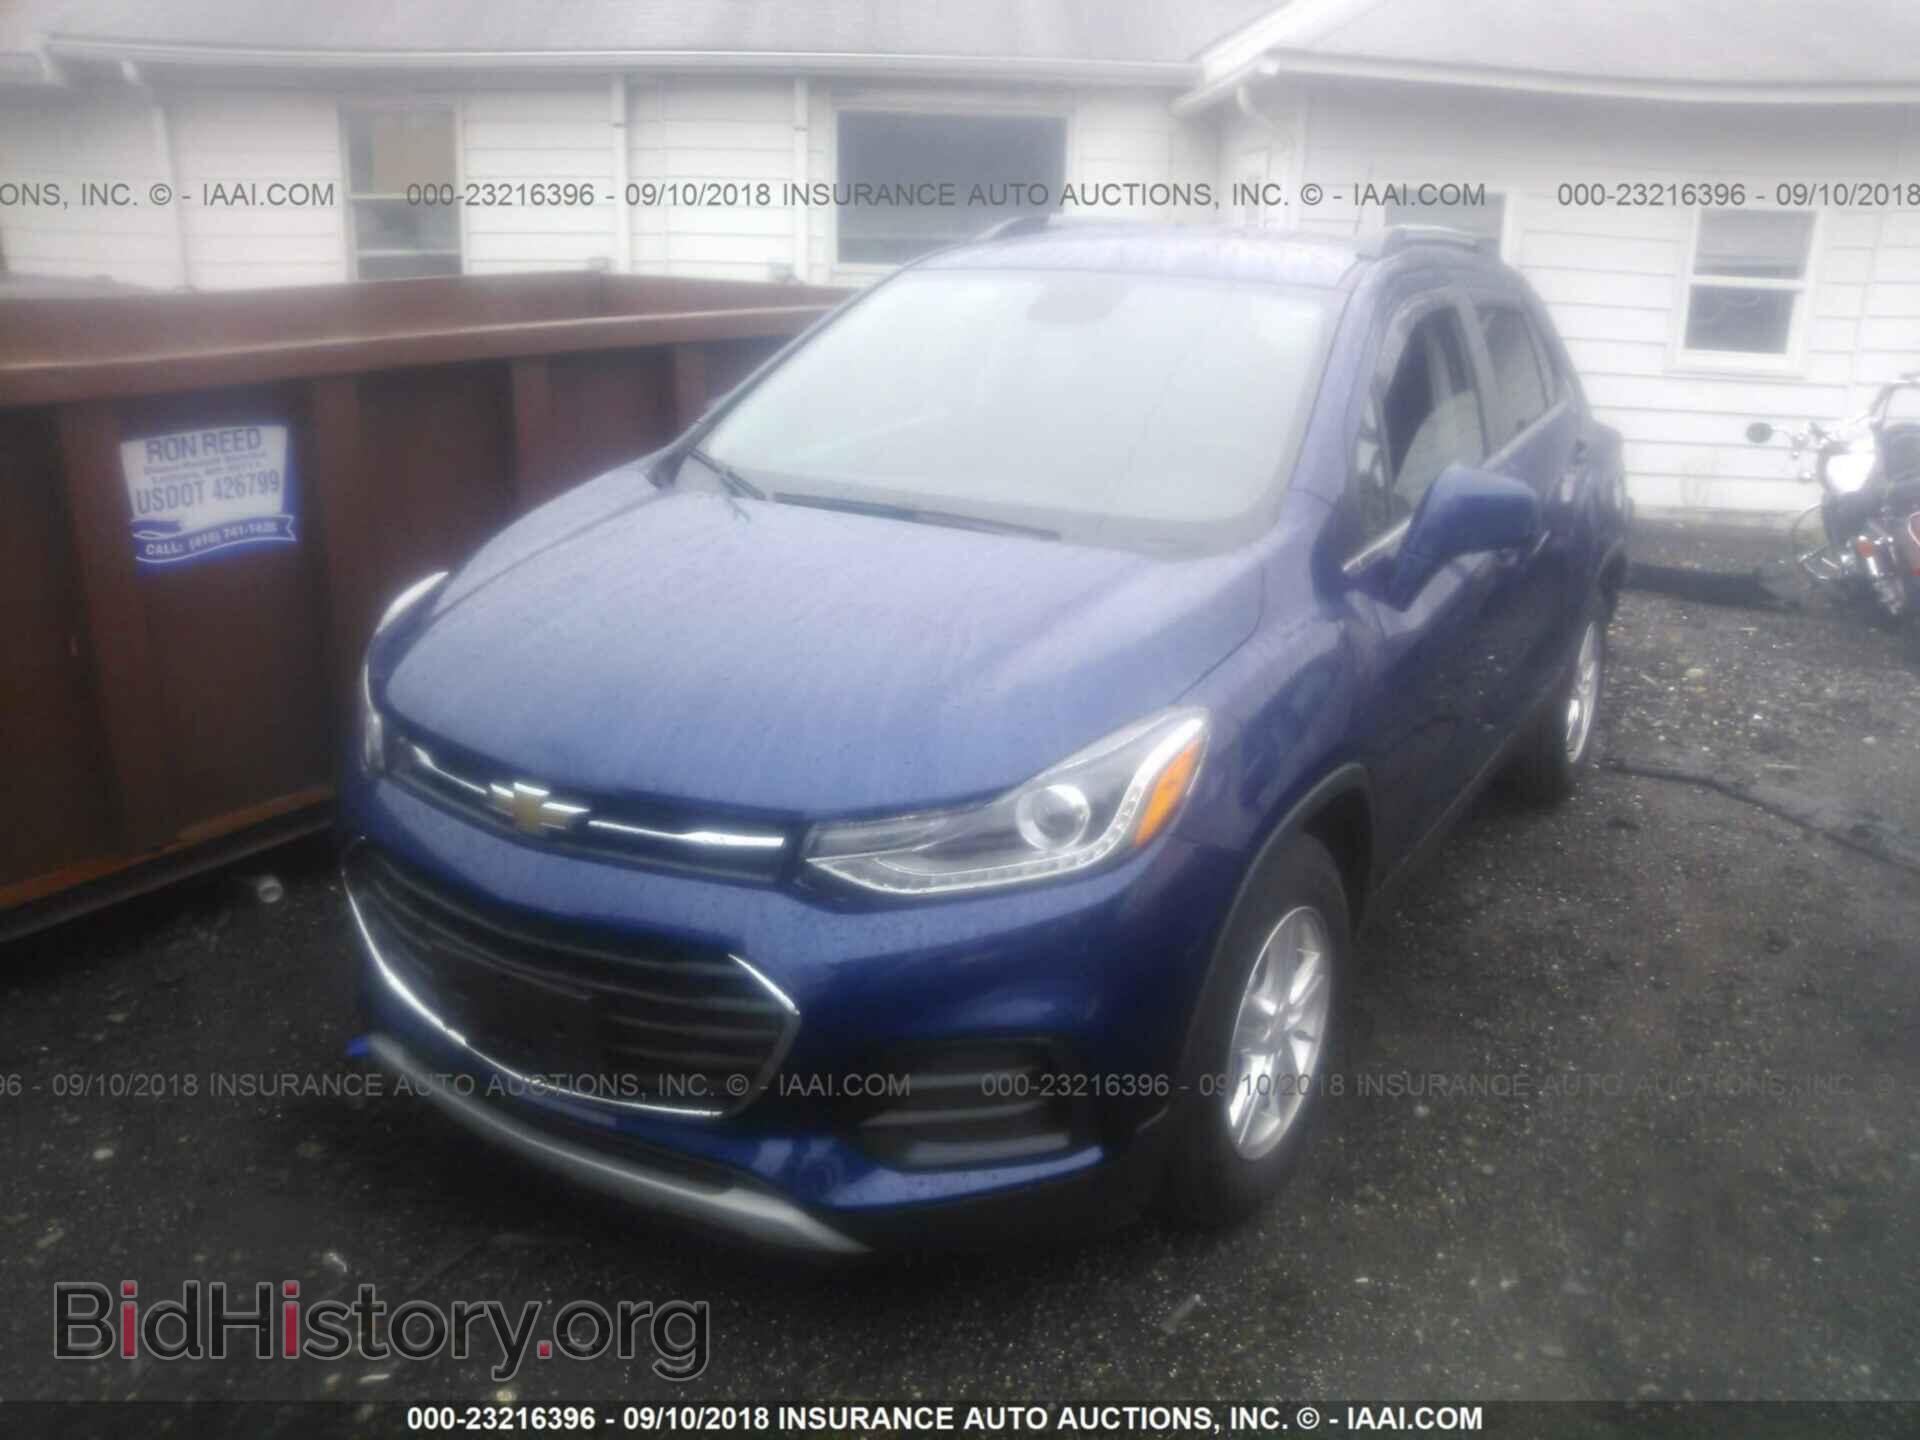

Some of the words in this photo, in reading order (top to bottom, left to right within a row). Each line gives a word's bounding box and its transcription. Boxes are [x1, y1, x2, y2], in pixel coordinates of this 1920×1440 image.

[144, 436, 197, 464] RON
[202, 427, 262, 455] REED
[136, 480, 205, 515] USDOT
[212, 469, 281, 501] 426799
